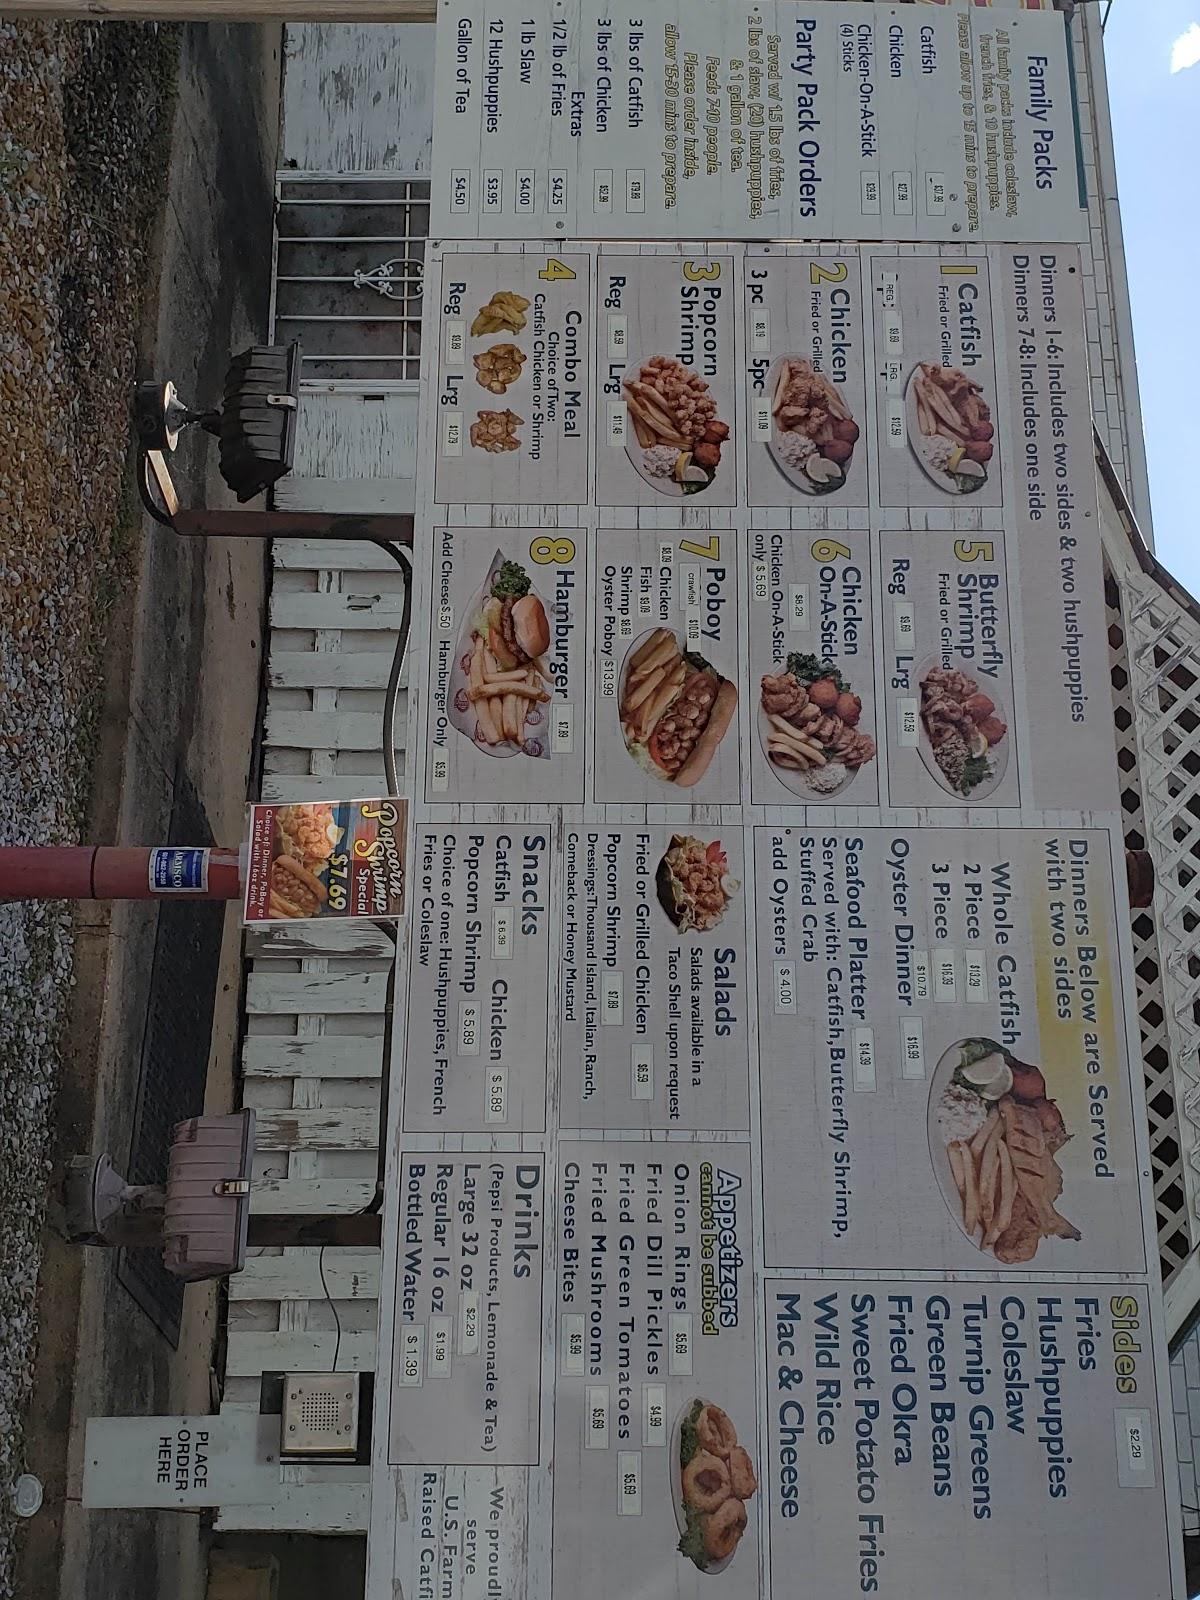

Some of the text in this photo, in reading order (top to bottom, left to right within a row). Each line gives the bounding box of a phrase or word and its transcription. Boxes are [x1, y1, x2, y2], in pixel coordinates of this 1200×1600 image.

[456, 19, 472, 113] Gallon of Tea
[520, 50, 534, 84] Slaw
[521, 32, 535, 44] lb
[889, 25, 903, 78] Chicken
[920, 26, 936, 74] Catfish
[484, 19, 503, 133] 12 Hushpuppies
[857, 24, 876, 157] Chicken-On-A-Stick
[570, 91, 585, 136] Extras
[704, 56, 722, 175] Feeds 7-10 people.
[791, 19, 822, 217] Party Pack Orders
[1026, 56, 1058, 189] Family Packs
[455, 177, 465, 205] $4.50
[519, 177, 530, 205] $4.00
[539, 259, 576, 281] 4
[684, 261, 721, 281] 3
[747, 270, 768, 303] 3 pc
[810, 262, 848, 284] 2
[885, 284, 894, 303] REG.
[1040, 255, 1058, 323] Dinners
[676, 286, 699, 366] Shrimp
[698, 287, 722, 376] Popcorn
[830, 288, 851, 383] Chicken
[889, 328, 899, 342] $9.69
[958, 283, 982, 367] Catfish
[546, 331, 560, 422] Choice of Two:
[564, 310, 582, 438] Combo Meal
[748, 359, 770, 389] 5pc
[888, 363, 898, 382] LRG.
[1047, 364, 1068, 437] Includes
[890, 417, 901, 435] $12.59
[1054, 443, 1069, 478] two
[1057, 484, 1075, 530] sides
[530, 536, 576, 564] 8
[678, 536, 720, 561] 7
[810, 539, 851, 562] 6
[954, 539, 994, 562] 5
[1059, 536, 1077, 551] &
[1060, 557, 1076, 594] two
[601, 566, 616, 656] Oyster Poboy
[618, 566, 633, 615] Shrimp
[640, 566, 653, 592] Fish
[659, 567, 671, 620] Chicken
[687, 573, 696, 605] crawfish
[701, 567, 726, 641] Poboy
[794, 594, 803, 617] $8.29
[842, 566, 862, 655] Chicken
[549, 570, 575, 699] Hamburger
[688, 620, 698, 639] $10.09
[820, 566, 837, 665] On-A-Stick
[955, 573, 979, 659] Shrimp
[977, 574, 1003, 679] Butterfly
[603, 660, 615, 696] $13.99
[1062, 600, 1088, 722] hushpuppies
[255, 820, 263, 841] Salad
[360, 802, 405, 898] Popcorn
[258, 882, 267, 906] PoBoy
[329, 853, 348, 910] $7.69
[354, 839, 388, 915] Shrimp
[357, 869, 370, 915] Special
[494, 836, 511, 902] Catfish
[521, 836, 546, 936] Snacks
[963, 863, 982, 940] 2 Piece
[258, 909, 263, 918] or
[845, 837, 869, 1020] Seafood Platter
[886, 838, 916, 1006] Oyster Dinner
[1045, 838, 1074, 1020] with two sides
[916, 965, 927, 997] $10.79
[967, 964, 982, 987] $13.29
[991, 862, 1020, 1046] Whole Catfish
[490, 979, 508, 1060] Chicken
[714, 948, 737, 1037] Salads
[1069, 839, 1115, 1179] Dinners Below are Served
[858, 1042, 873, 1065] $14.39
[513, 1164, 540, 1278] Drinks
[562, 1162, 579, 1302] Cheese Bites
[670, 1163, 690, 1310] Onion Rings
[701, 1162, 719, 1335] cannot be subbed
[712, 1169, 743, 1328] Appetizers
[435, 1332, 445, 1360] $1.99
[466, 1308, 476, 1337] $2.29
[570, 1334, 582, 1354] $5.99
[676, 1333, 688, 1354] $5.69
[1075, 1298, 1101, 1371] Fries
[1110, 1296, 1141, 1394] Sides
[814, 1292, 841, 1445] Wild Rice
[887, 1295, 917, 1465] Fried Okra
[926, 1295, 955, 1497] Green Beans
[1000, 1296, 1029, 1434] Coleslaw
[1035, 1297, 1072, 1498] Hushpuppies
[776, 1294, 804, 1518] Mac & Cheese
[959, 1295, 994, 1519] Turnip Greens
[157, 1437, 171, 1483] HERE
[175, 1429, 190, 1491] ORDER
[194, 1431, 208, 1488] PLACE
[851, 1294, 885, 1592] Sweet Potato Fries
[1129, 1429, 1141, 1458] $2.29
[420, 1473, 436, 1600] Raised Catfi
[442, 1496, 458, 1598] U.S. Farm
[466, 1520, 477, 1575] serve
[485, 1487, 504, 1600] We proudl
